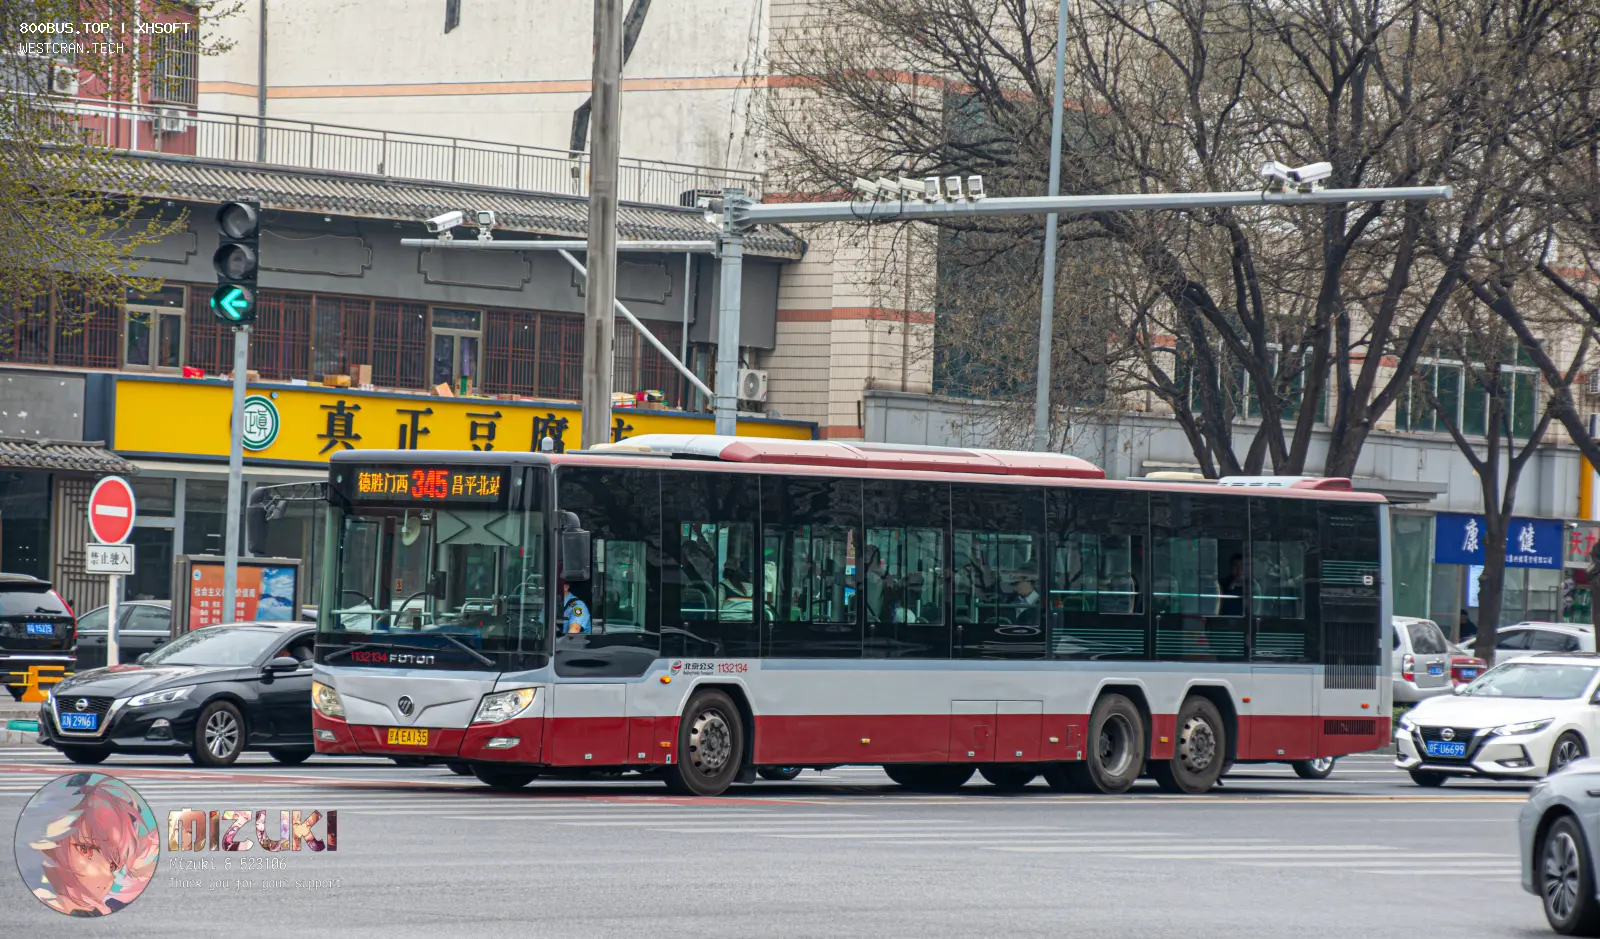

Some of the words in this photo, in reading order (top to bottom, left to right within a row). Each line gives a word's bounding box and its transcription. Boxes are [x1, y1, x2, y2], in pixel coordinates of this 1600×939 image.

[317, 400, 634, 455] 真正豆腐
[358, 472, 409, 493] 德胜门西
[411, 469, 449, 498] 345
[451, 474, 501, 496] 昌平北站
[1462, 518, 1538, 554] 康健
[90, 551, 130, 566] 禁止驶入
[193, 586, 256, 598] 社会主义价值观
[349, 651, 387, 663] 1132134
[389, 654, 435, 665] FOTON
[684, 662, 715, 670] 北京公交
[717, 663, 748, 674] 1132134
